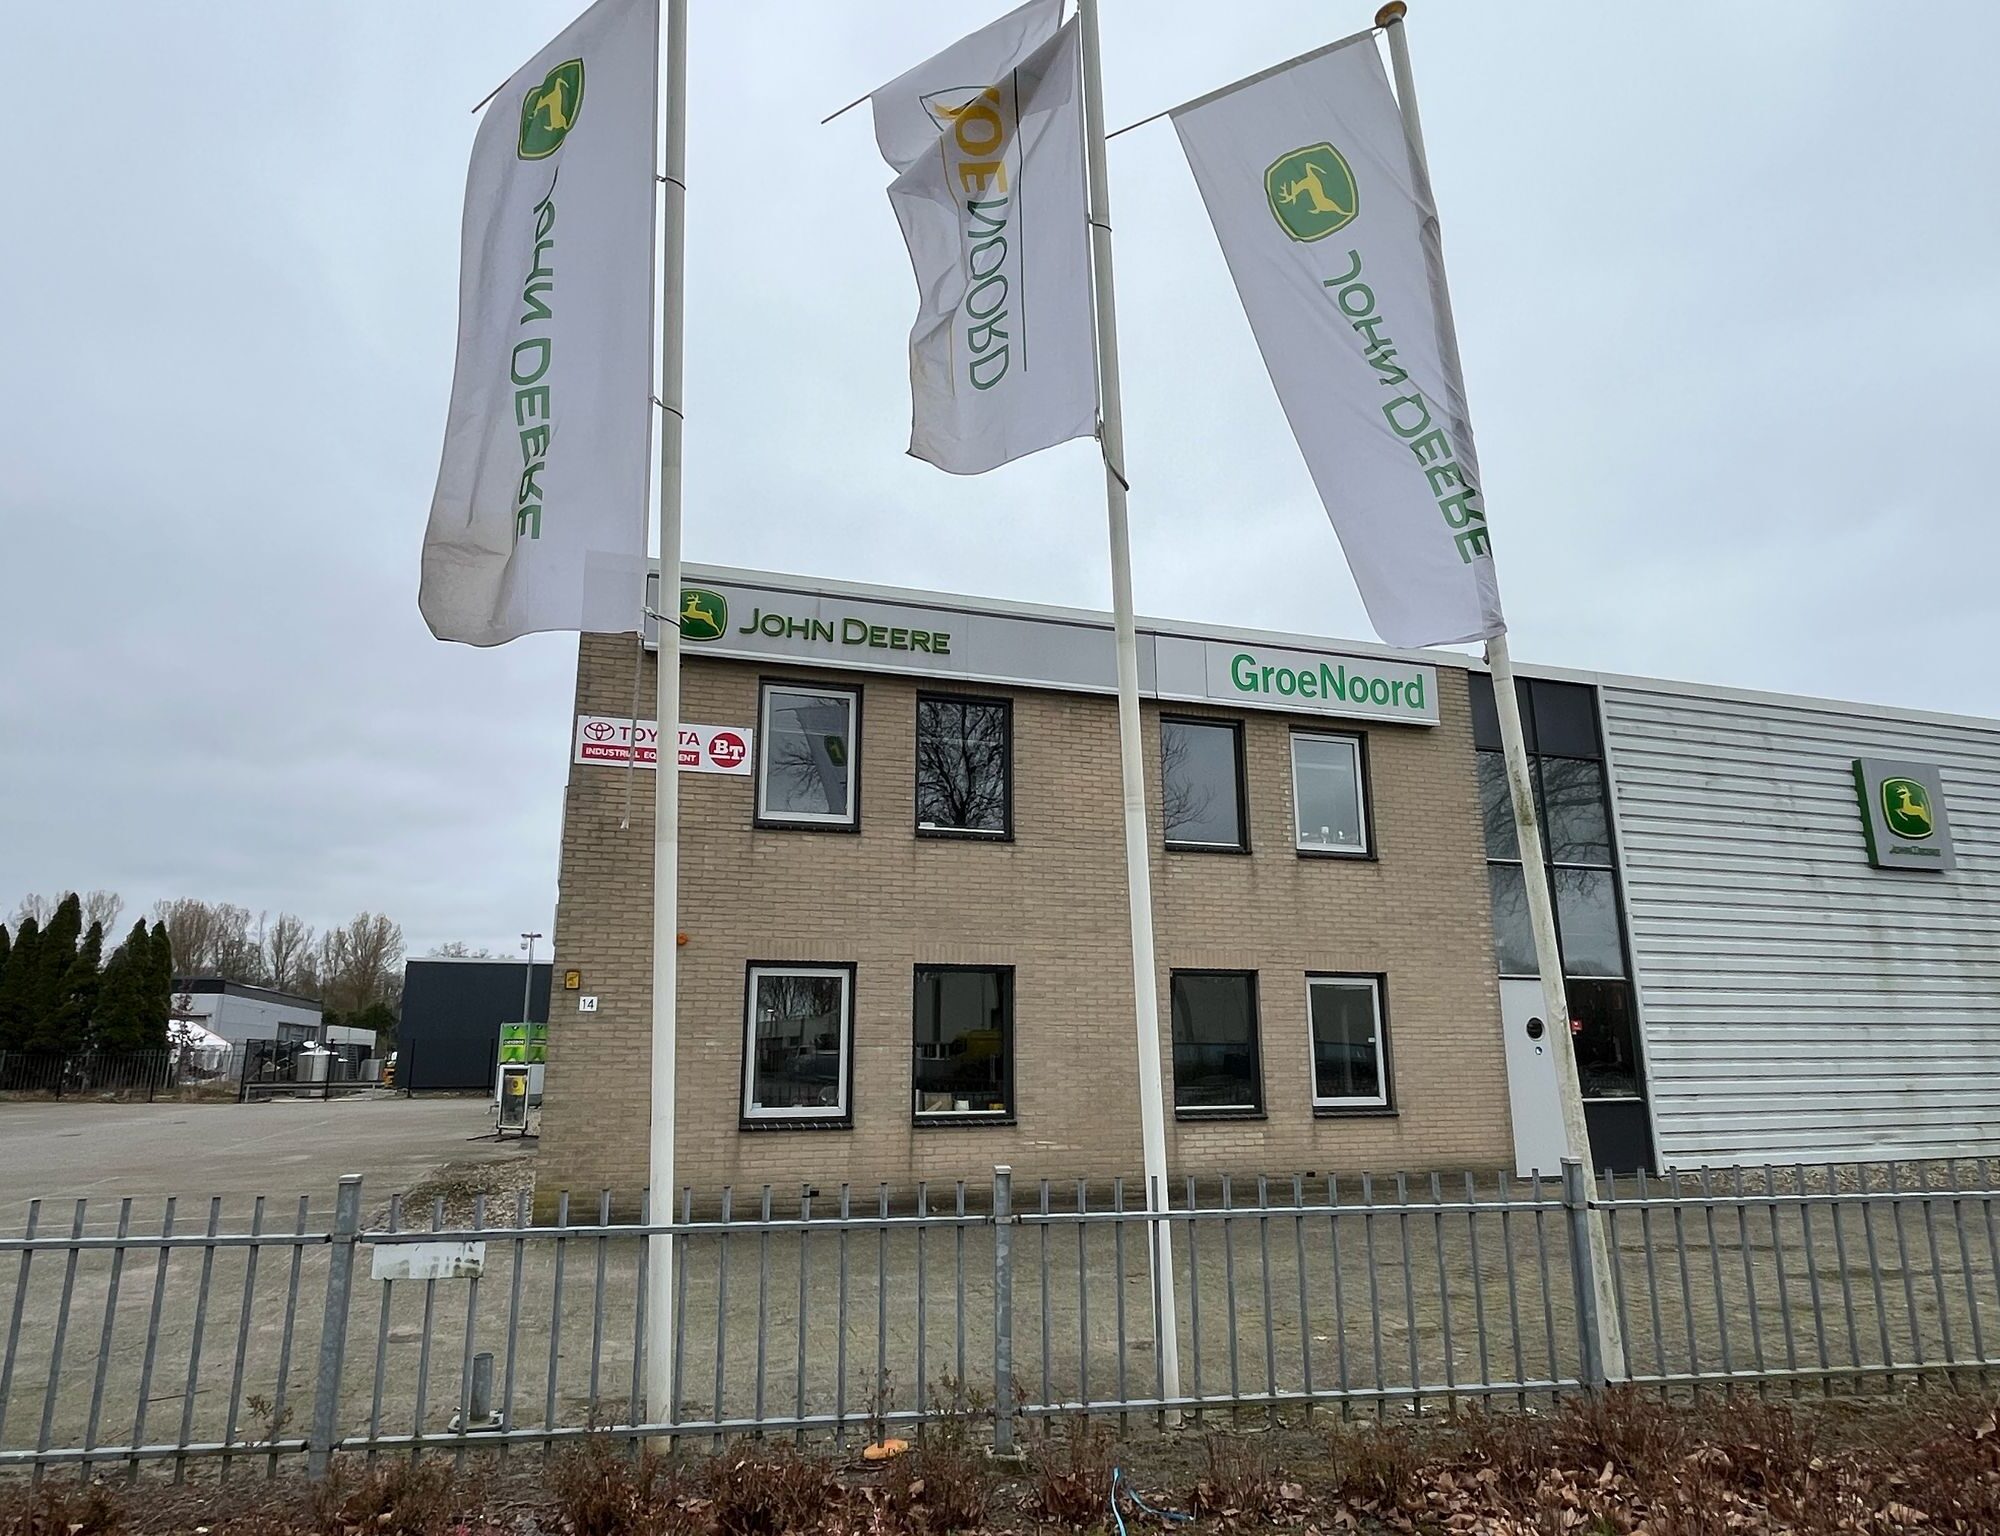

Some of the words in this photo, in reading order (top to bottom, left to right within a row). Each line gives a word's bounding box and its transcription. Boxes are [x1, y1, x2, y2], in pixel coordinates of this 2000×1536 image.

[739, 607, 835, 643] JOHN
[841, 617, 951, 655] DEERE
[1230, 653, 1425, 709] GroeNoord
[618, 726, 701, 747] TOYTA
[643, 750, 697, 763] EQENT
[582, 998, 594, 1010] 14
